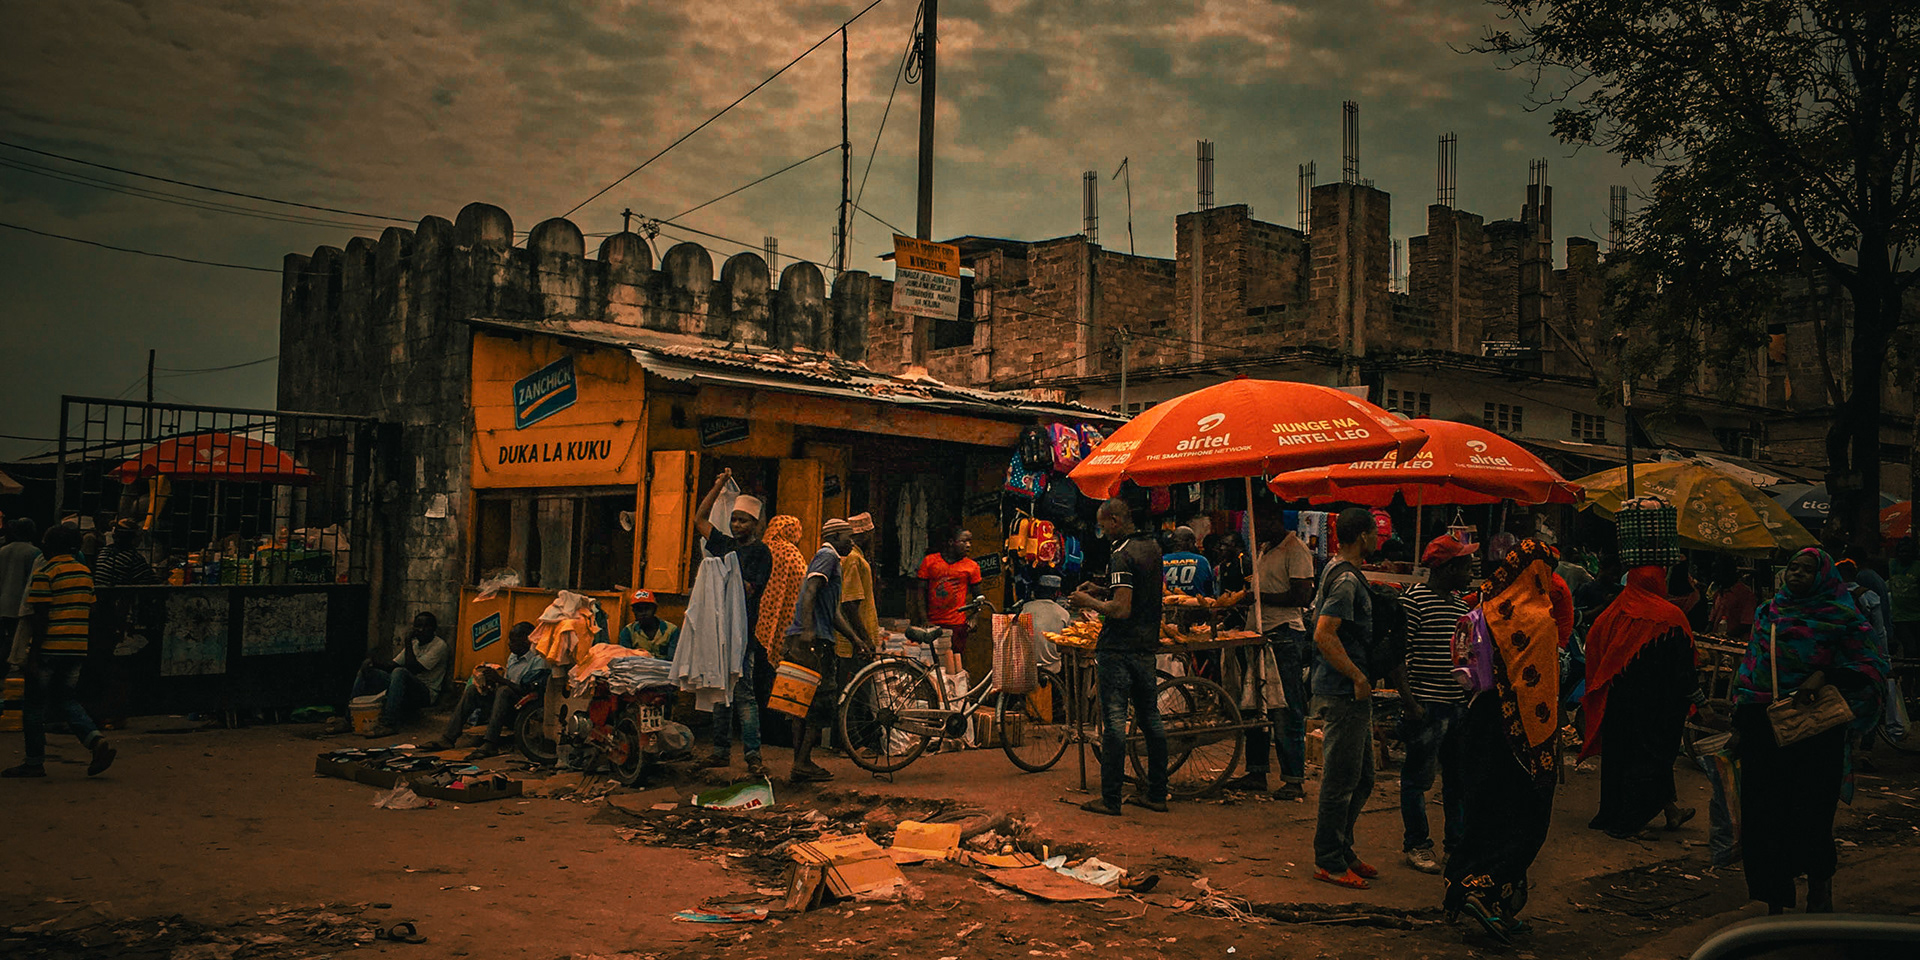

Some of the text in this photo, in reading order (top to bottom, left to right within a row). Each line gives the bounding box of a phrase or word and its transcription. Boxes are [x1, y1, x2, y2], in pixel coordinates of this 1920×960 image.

[519, 366, 571, 405] ZANCHICK
[1271, 420, 1331, 434] JIUNGE
[1332, 417, 1360, 428] NA
[1176, 433, 1231, 451] airtel
[1278, 428, 1370, 446] AIRTEL LEO
[498, 440, 611, 465] DUKA LA KUKU
[1162, 450, 1213, 460] SMARTPHONE
[1214, 445, 1252, 454] NETWORK
[1469, 454, 1512, 467] airtel
[1349, 460, 1433, 469] AIRTEL LEO
[1802, 500, 1830, 514] tig
[1165, 566, 1197, 584] 40
